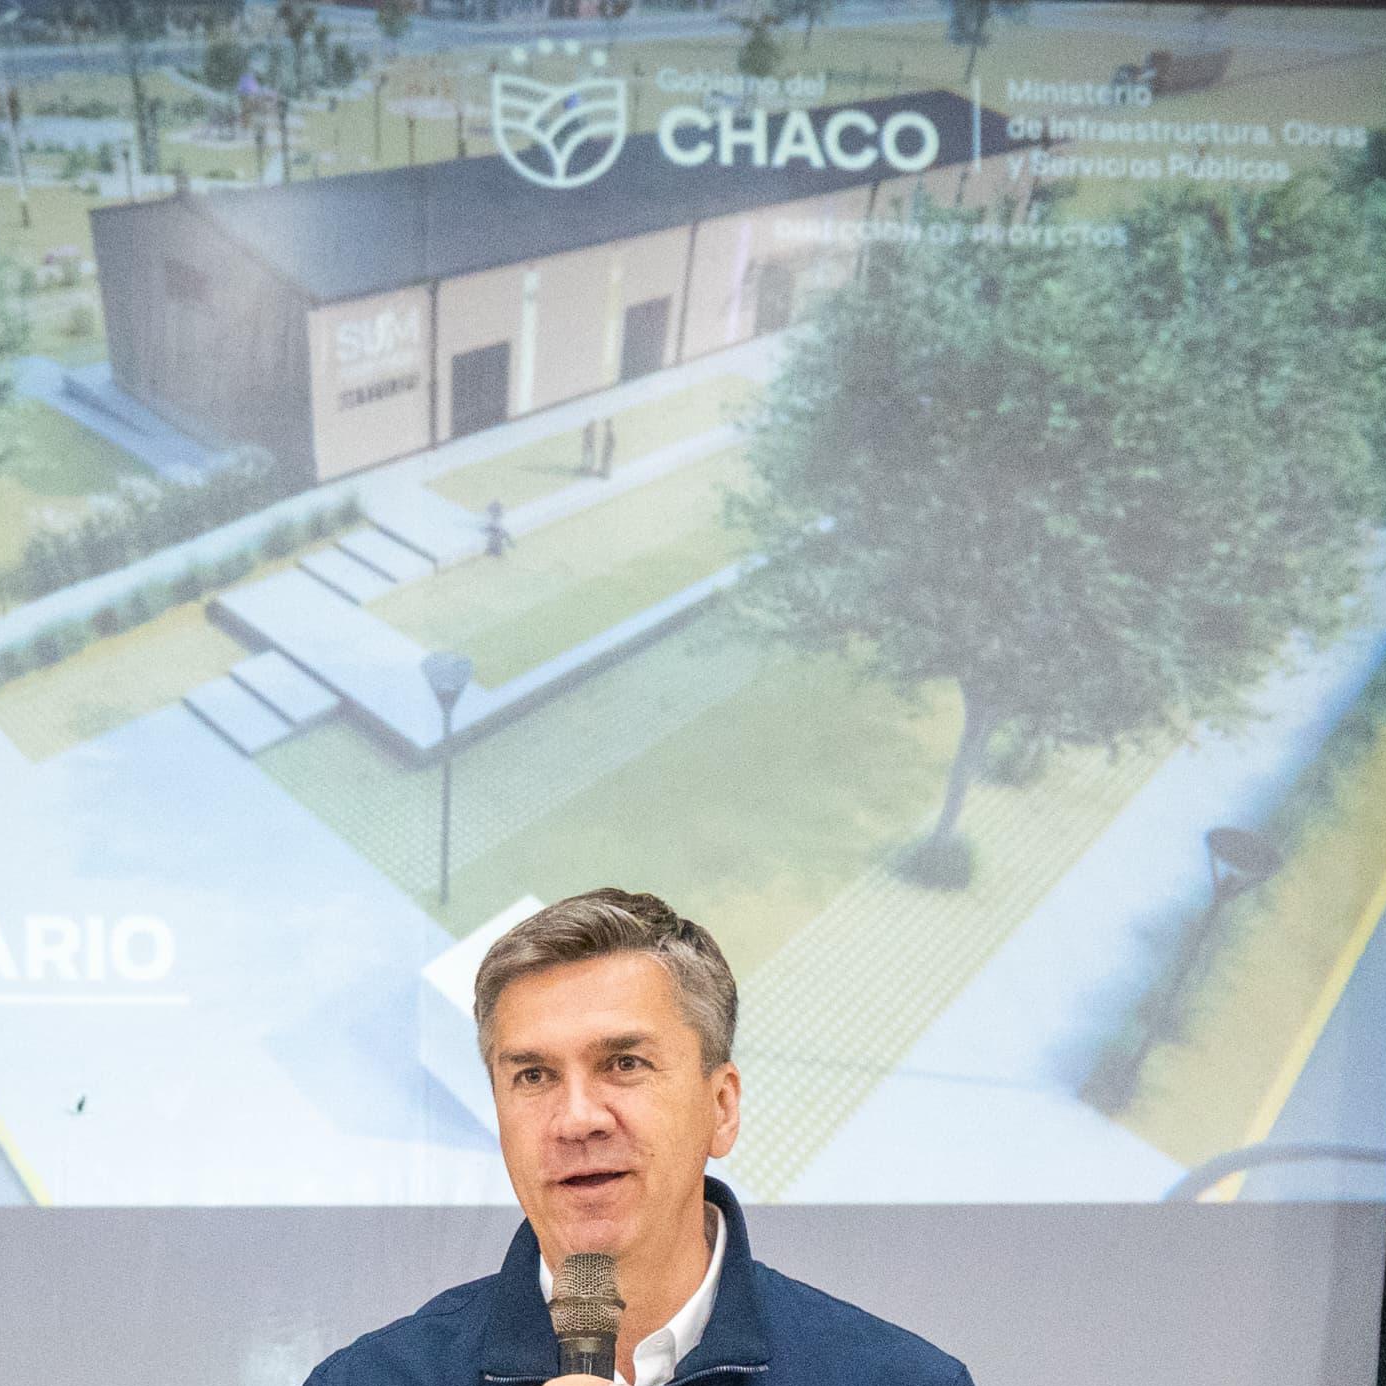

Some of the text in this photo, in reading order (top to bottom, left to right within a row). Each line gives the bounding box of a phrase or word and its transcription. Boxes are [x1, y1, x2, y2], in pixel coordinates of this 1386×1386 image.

[656, 67, 827, 98] Gobierno del
[1007, 80, 1154, 108] Ministerio
[658, 106, 940, 172] CHACO
[1007, 117, 1043, 139] de
[1281, 120, 1368, 147] Obras
[1006, 155, 1024, 182] y
[1028, 150, 1162, 179] Servicios
